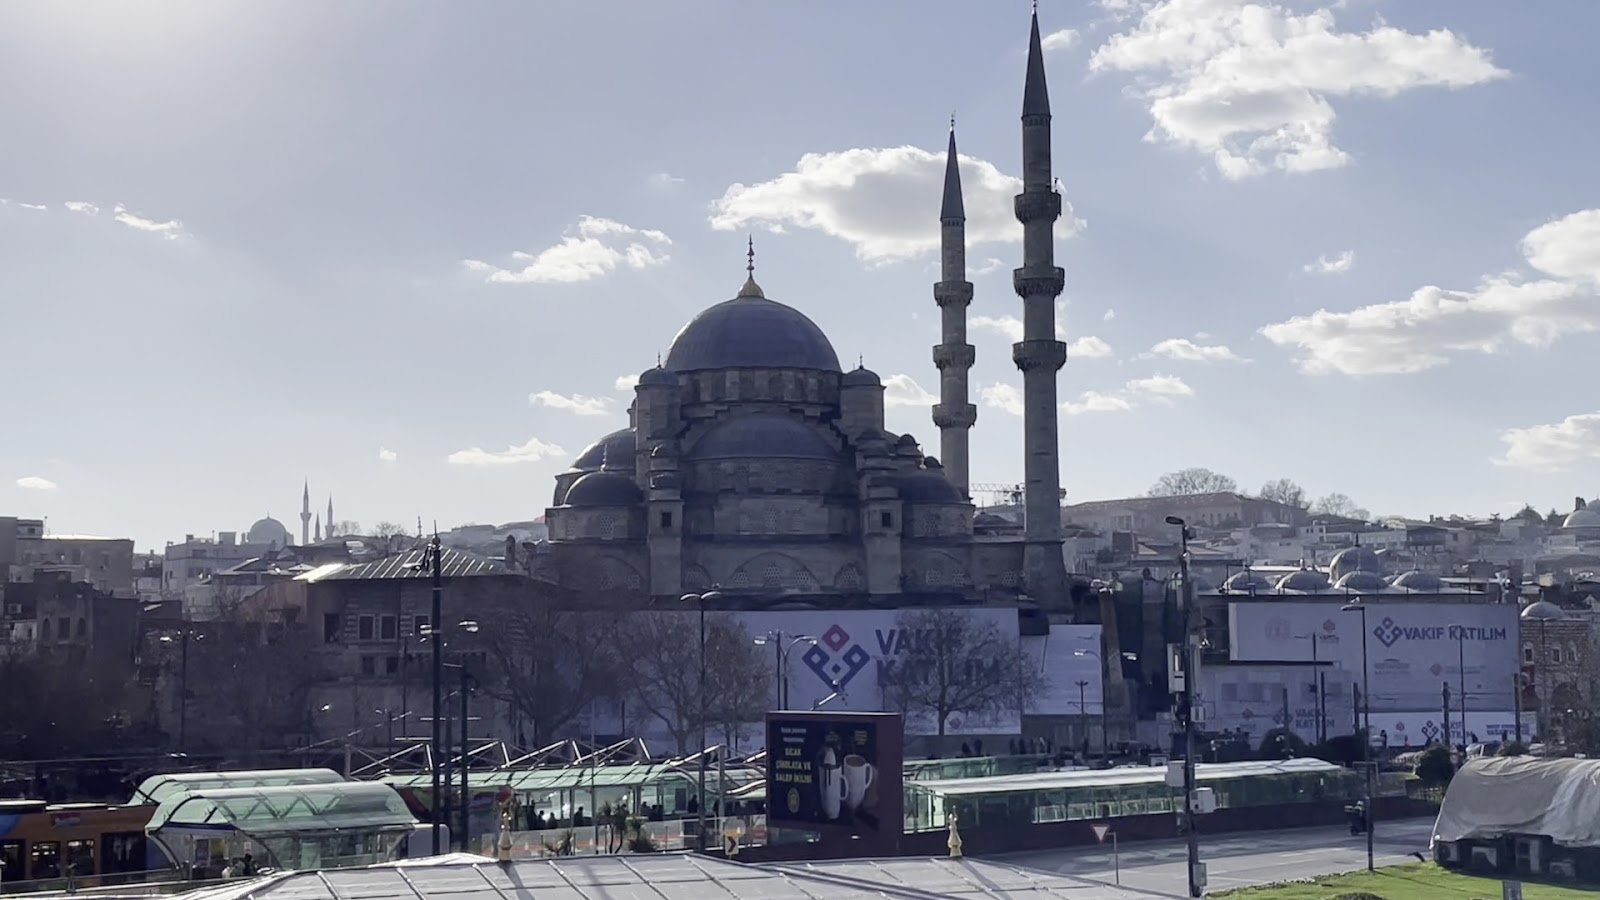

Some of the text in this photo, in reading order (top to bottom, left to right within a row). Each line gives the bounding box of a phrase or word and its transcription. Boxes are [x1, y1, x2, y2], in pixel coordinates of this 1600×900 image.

[875, 629, 962, 655] VAKF
[1403, 626, 1506, 640] VAKIF KATILIM
[876, 659, 1000, 685] KATLIM
